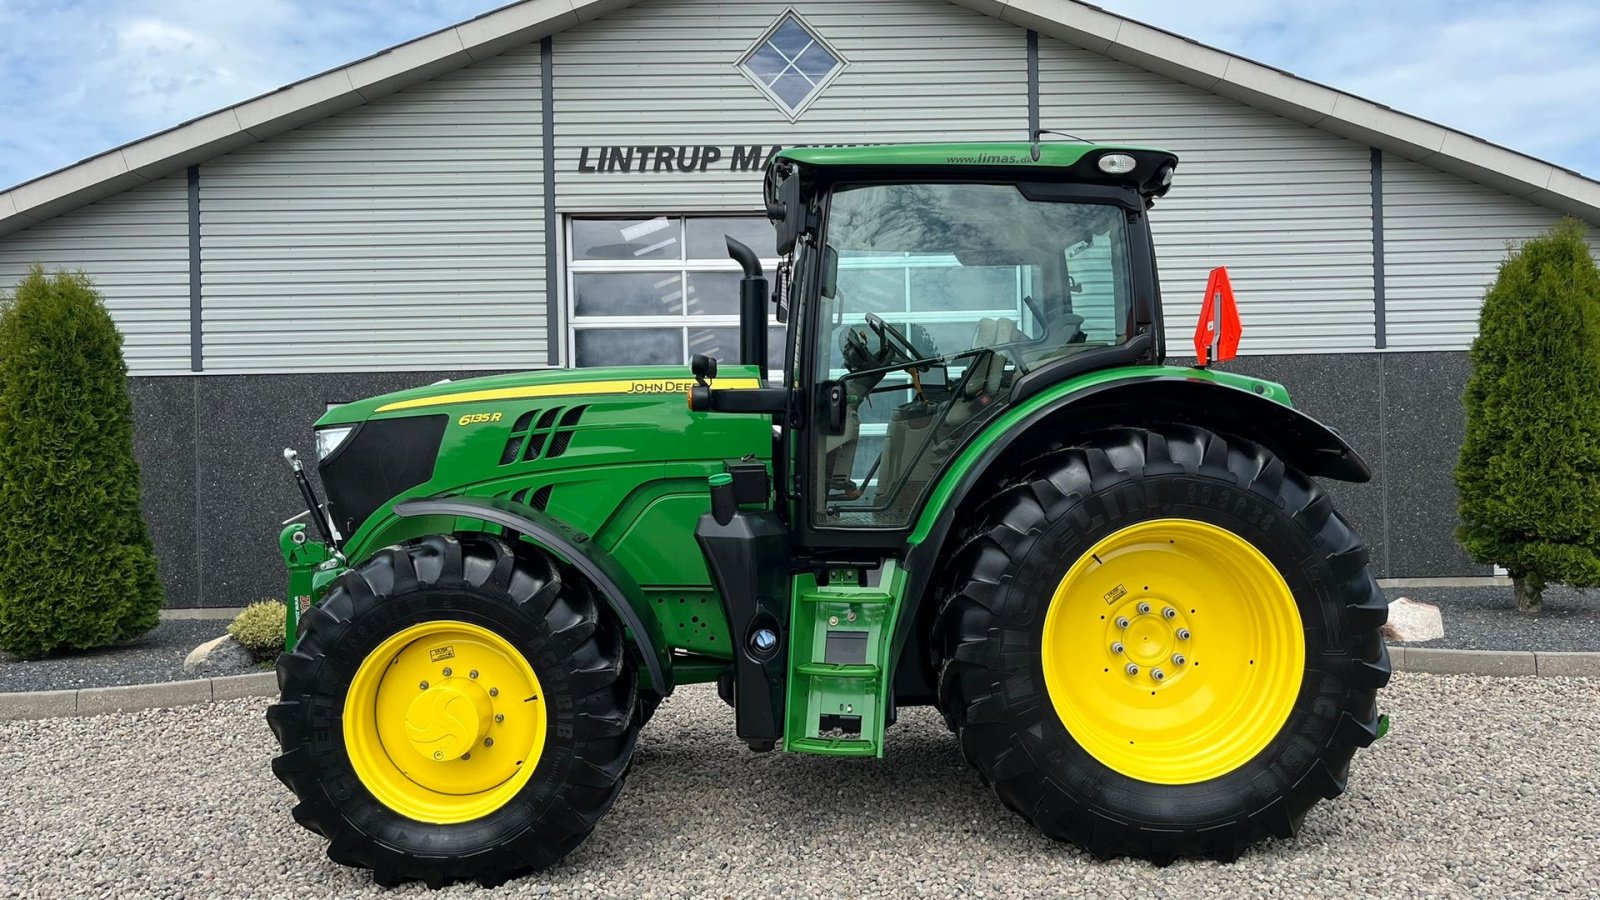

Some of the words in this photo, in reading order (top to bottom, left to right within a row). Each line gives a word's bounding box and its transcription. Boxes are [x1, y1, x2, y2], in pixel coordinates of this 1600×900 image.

[577, 145, 722, 173] LINTRUP
[946, 153, 1033, 164] www.limas.dk
[627, 382, 663, 392] JOHN
[665, 381, 698, 392] DEE
[458, 413, 491, 426] 6135
[491, 412, 502, 422] R
